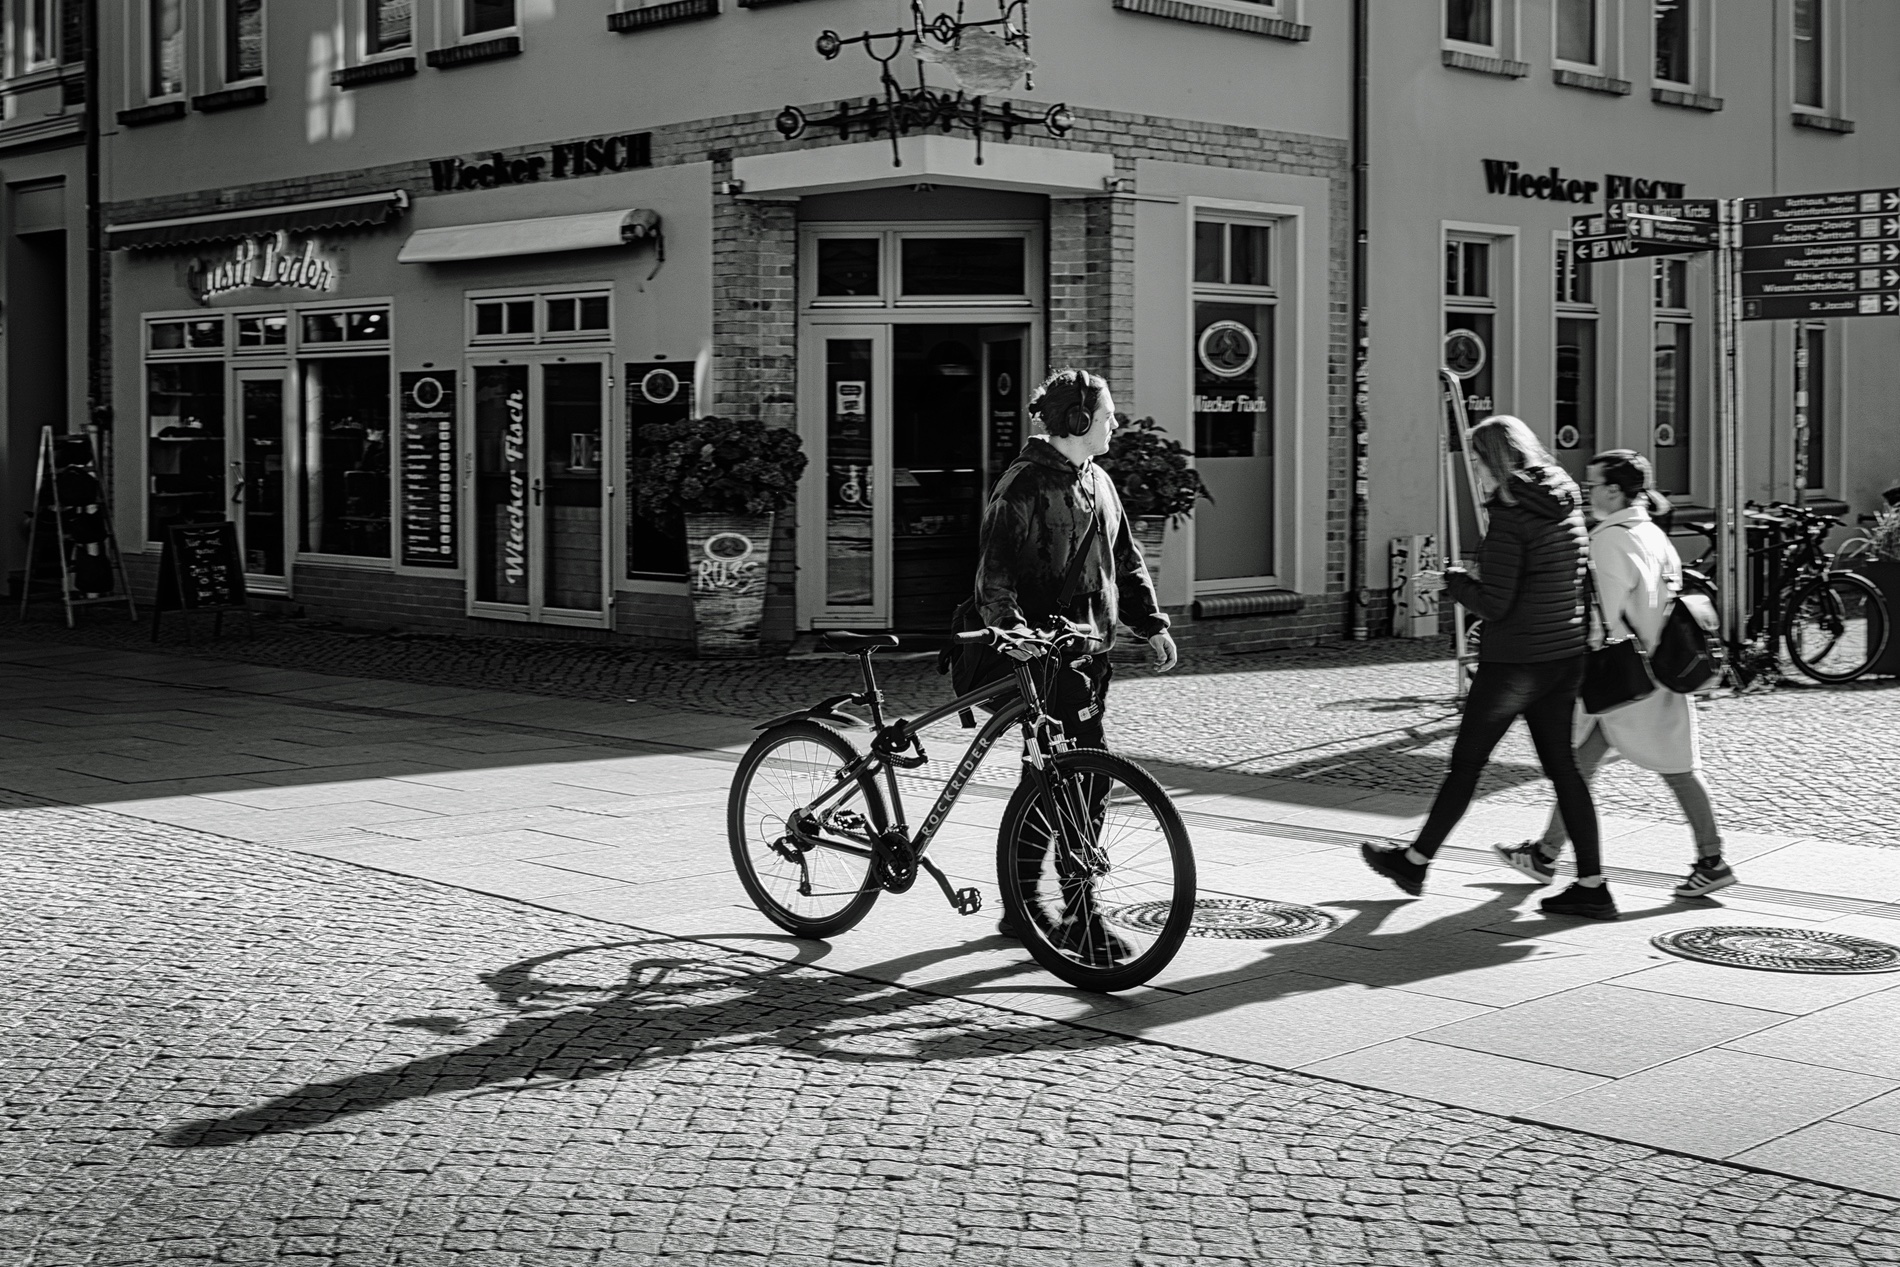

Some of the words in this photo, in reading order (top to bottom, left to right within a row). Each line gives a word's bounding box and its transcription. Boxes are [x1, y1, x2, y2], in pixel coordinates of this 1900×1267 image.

[430, 152, 546, 191] Wiecker
[551, 132, 652, 177] FISCH
[1481, 159, 1599, 204] Wiecker
[1611, 239, 1639, 255] WC
[505, 389, 524, 462] Fisch
[505, 468, 524, 584] Wiecker
[921, 737, 991, 836] ROCKRIDER
